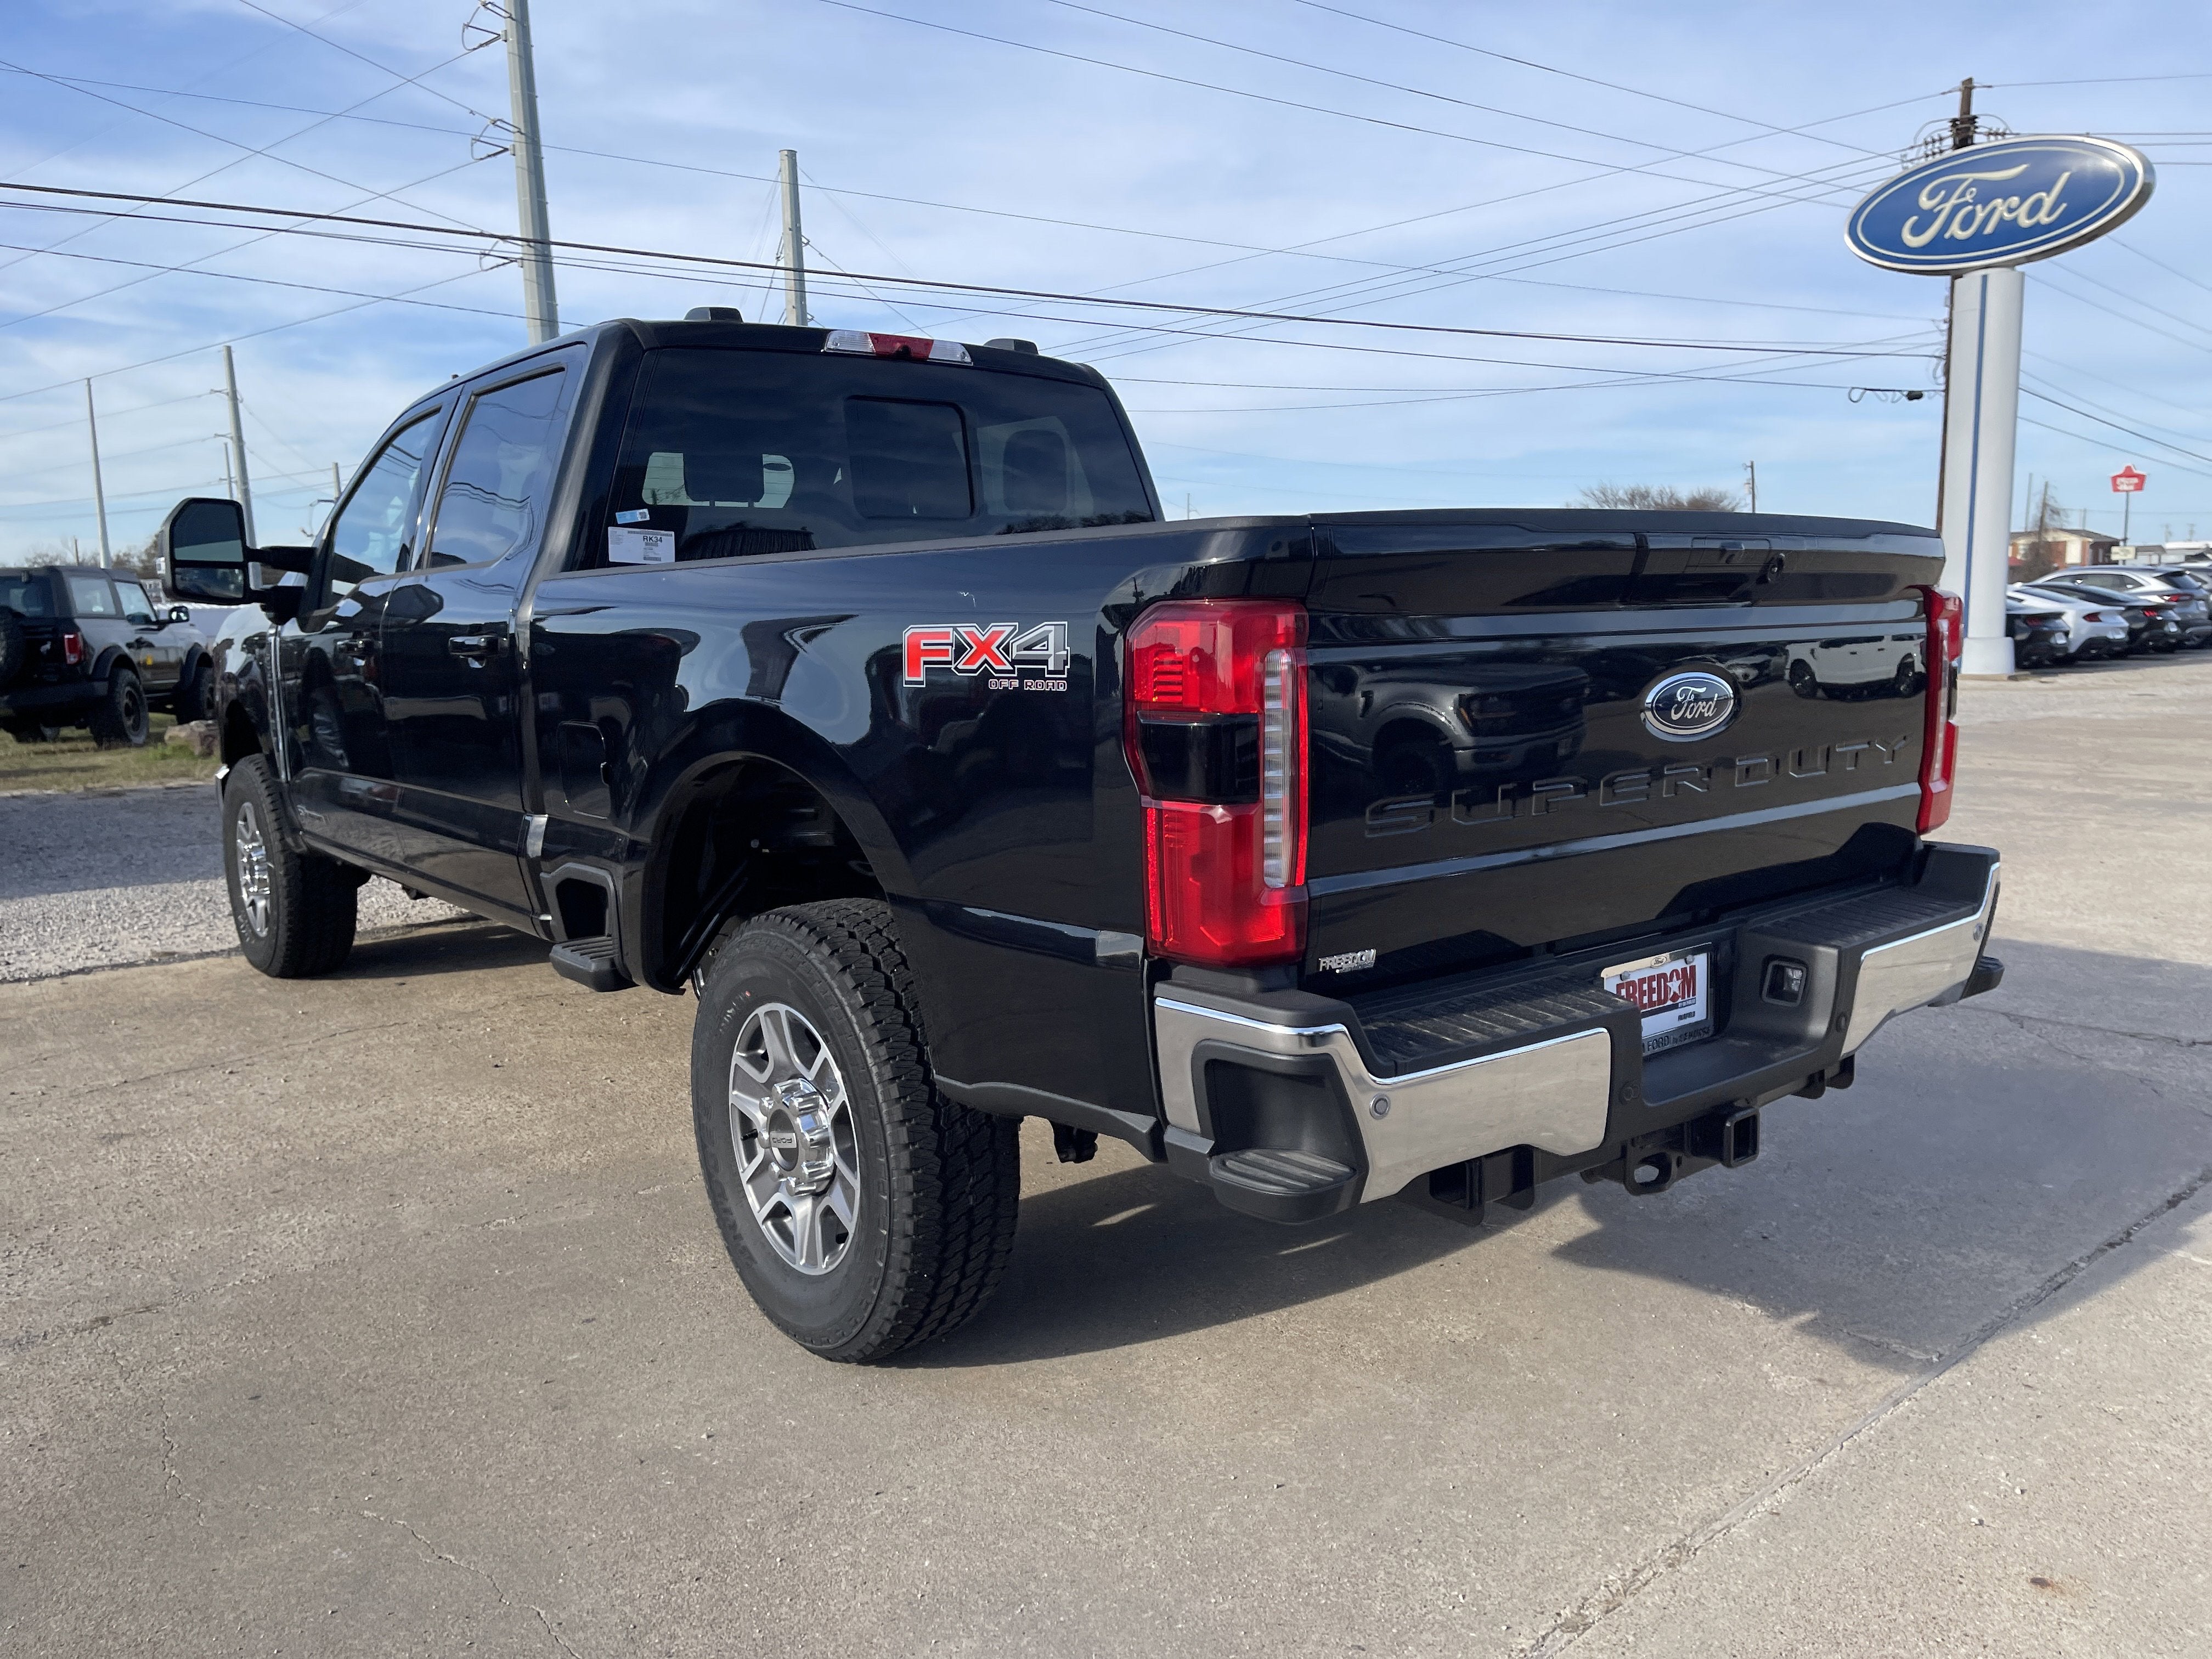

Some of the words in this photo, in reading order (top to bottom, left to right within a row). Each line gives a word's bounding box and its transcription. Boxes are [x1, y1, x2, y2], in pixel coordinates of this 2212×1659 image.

[1901, 163, 2072, 247] Ford
[903, 622, 1070, 687] FX4
[989, 679, 1019, 690] OFF
[1024, 680, 1066, 691] ROAD
[1671, 686, 1718, 720] Ford
[1365, 759, 1712, 838] SUPER
[1735, 733, 1913, 787] DUTY
